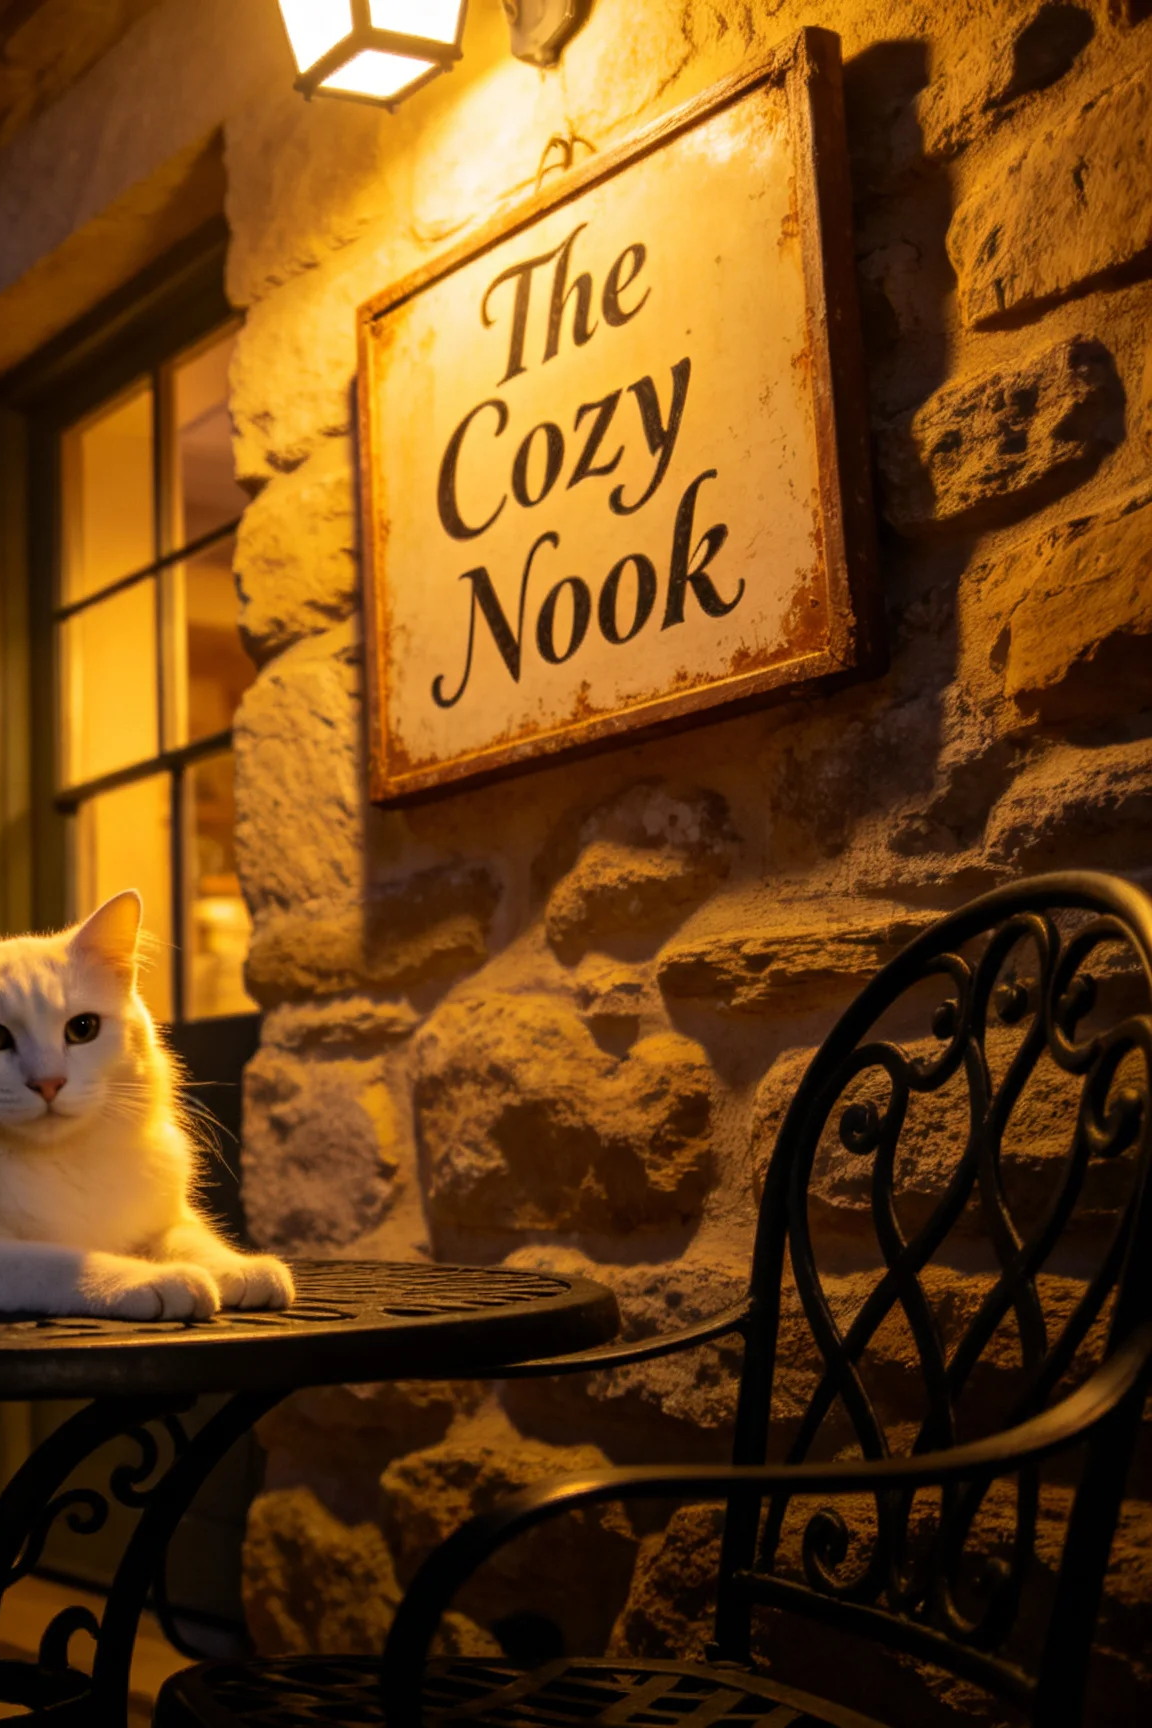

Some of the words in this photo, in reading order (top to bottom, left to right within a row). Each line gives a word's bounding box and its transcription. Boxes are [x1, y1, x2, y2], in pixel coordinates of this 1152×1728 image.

[481, 223, 652, 387] The
[437, 356, 691, 540] Cozy
[431, 468, 745, 708] Nook
